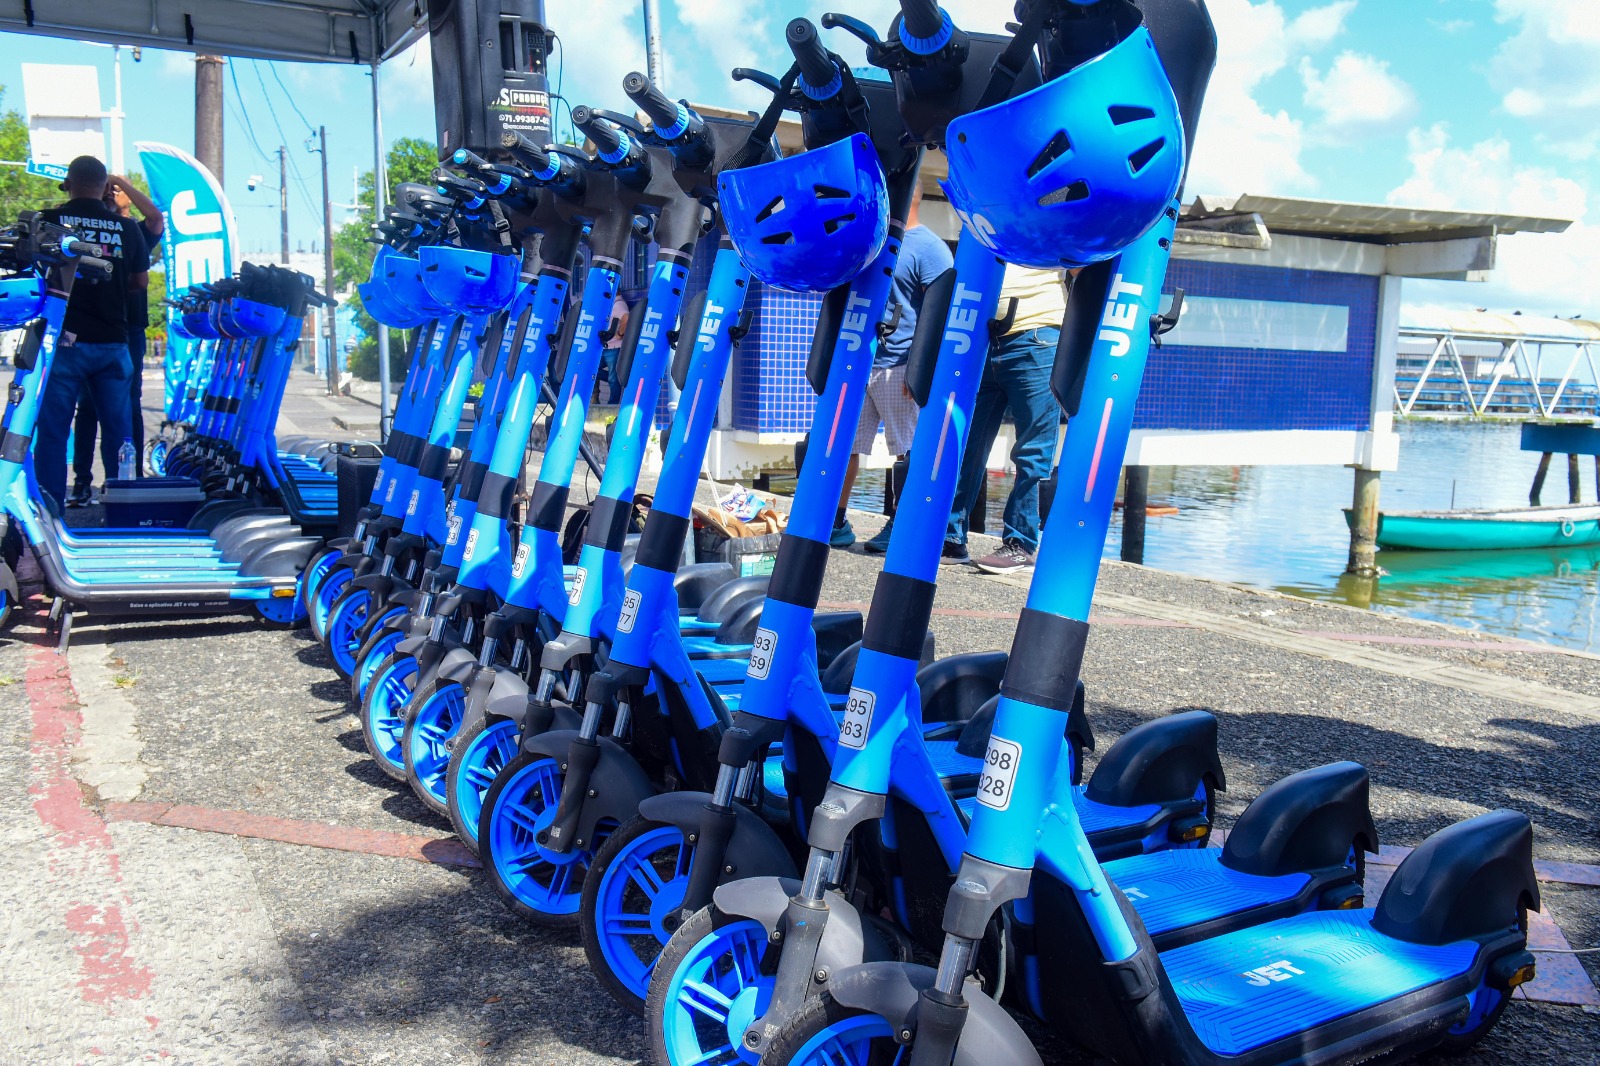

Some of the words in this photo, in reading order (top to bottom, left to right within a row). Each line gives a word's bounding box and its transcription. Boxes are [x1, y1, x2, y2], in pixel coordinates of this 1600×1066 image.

[59, 215, 124, 232] IMPRENSA
[100, 231, 123, 246] DA
[170, 189, 225, 289] JE
[523, 313, 544, 353] JET
[573, 309, 595, 353] JET
[638, 306, 663, 354] JET
[696, 299, 724, 352] JET
[840, 290, 871, 352] JET
[945, 282, 982, 355] JET
[1098, 273, 1143, 357] JET
[43, 324, 58, 354] JET
[432, 321, 447, 351] JET
[457, 319, 473, 351] JET
[501, 316, 518, 353] JET
[749, 655, 766, 670] 59
[985, 746, 1012, 770] 298
[1242, 960, 1306, 987] JET
